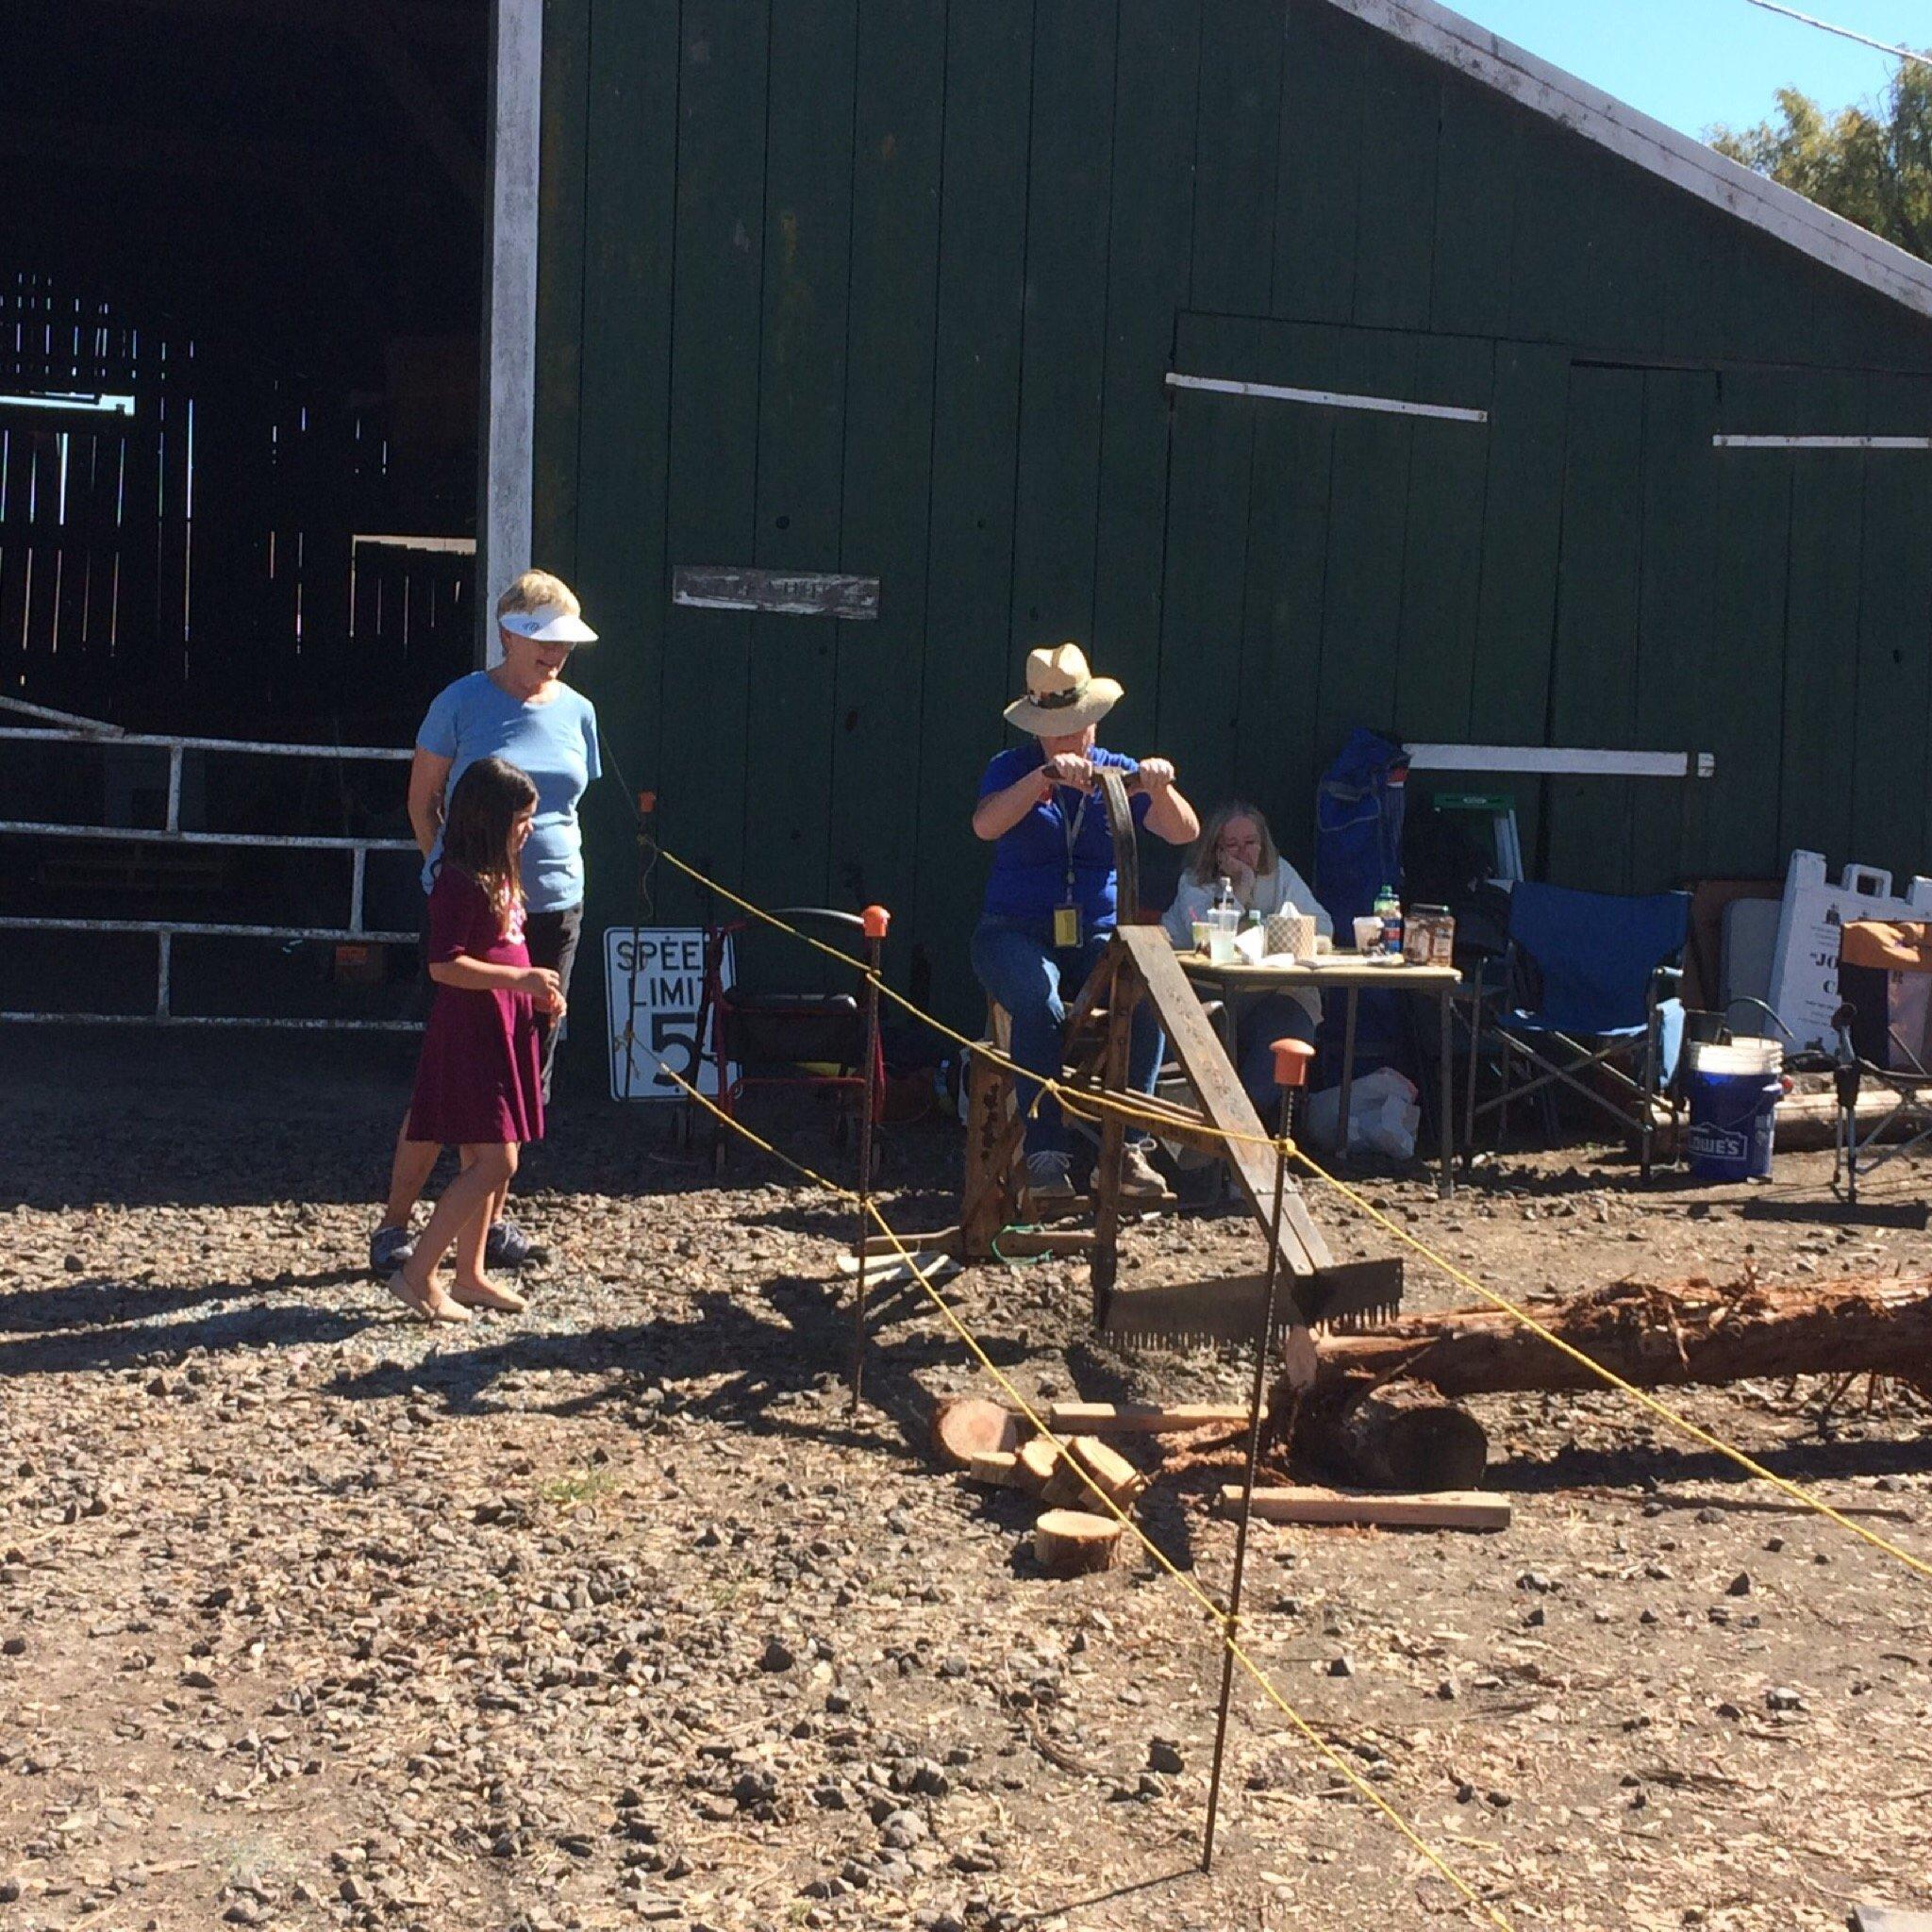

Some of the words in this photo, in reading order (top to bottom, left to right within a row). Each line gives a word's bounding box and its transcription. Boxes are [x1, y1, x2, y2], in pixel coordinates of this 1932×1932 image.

[617, 940, 708, 972] SPEE
[628, 975, 705, 1007] LIMI
[651, 1011, 700, 1087] 5
